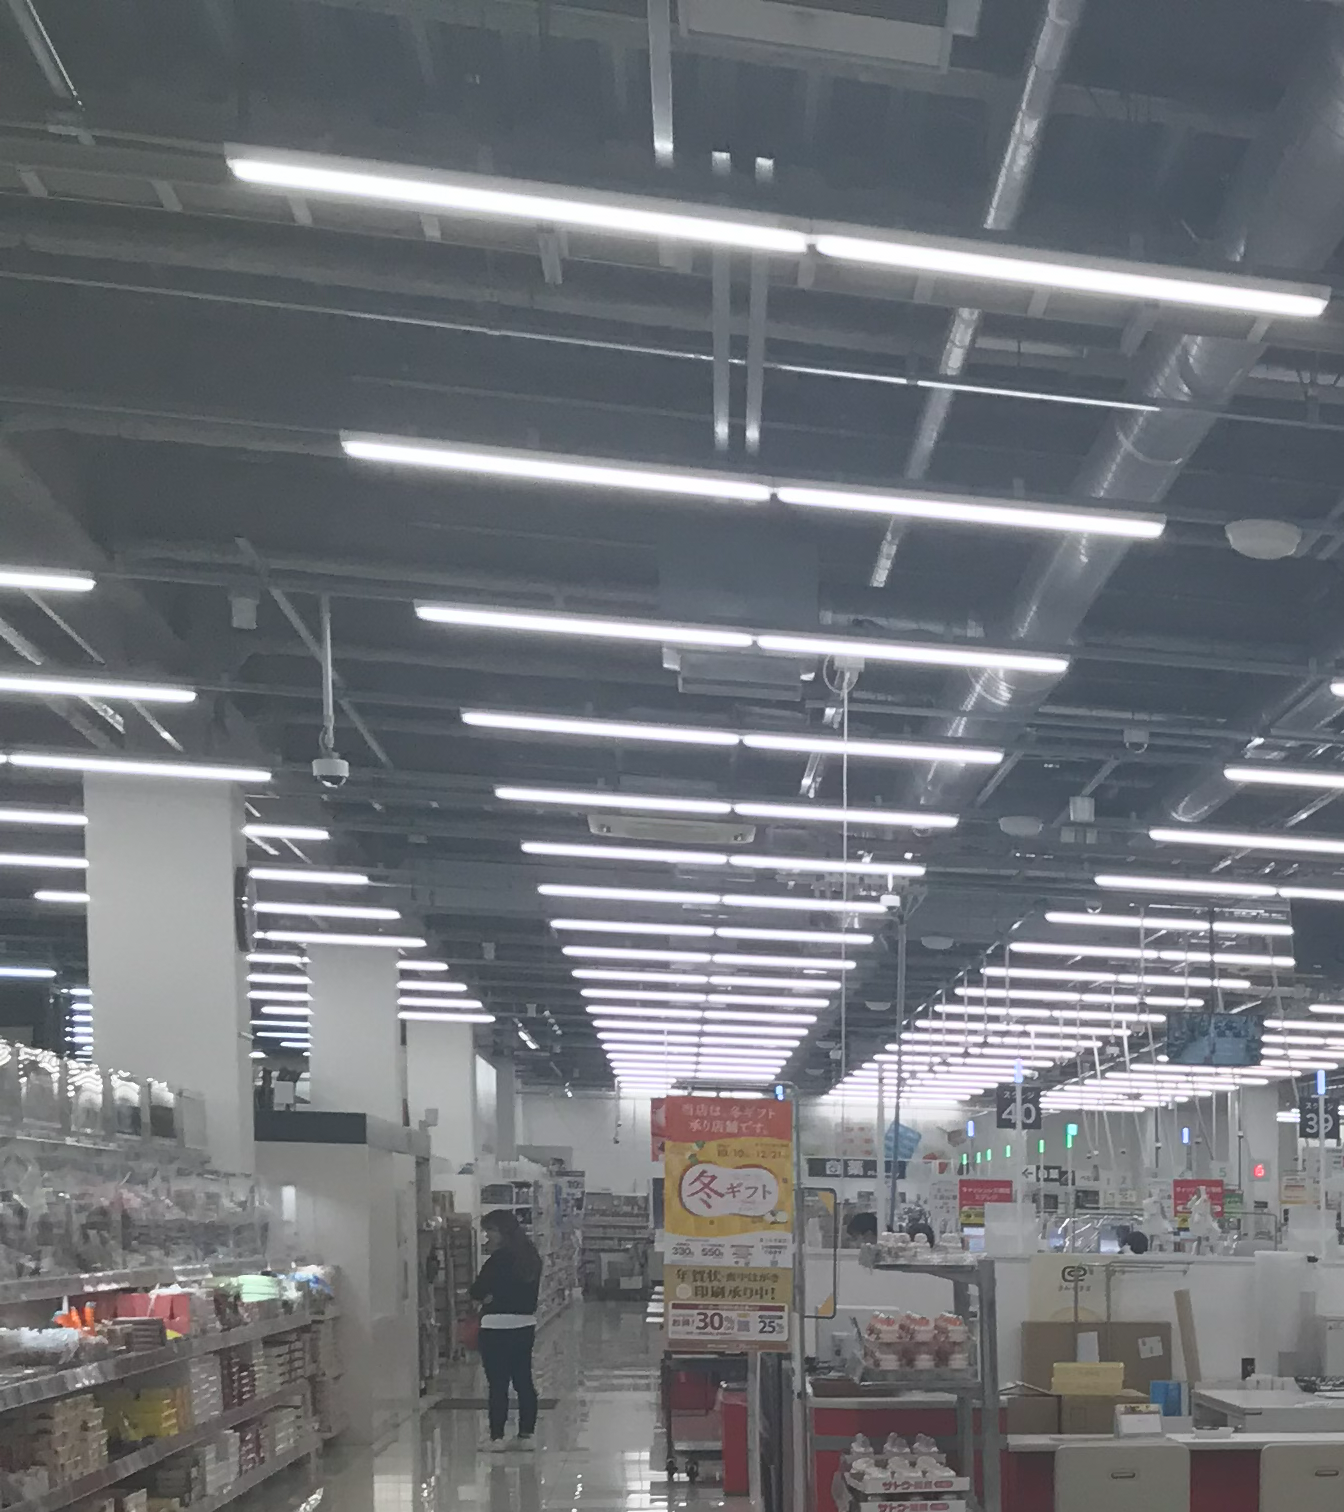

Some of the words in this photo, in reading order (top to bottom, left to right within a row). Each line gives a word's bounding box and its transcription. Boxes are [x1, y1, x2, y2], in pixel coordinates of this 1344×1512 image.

[1001, 1102, 1036, 1124] 40
[1305, 1113, 1334, 1133] 39
[687, 1169, 773, 1210] 冬ギフト
